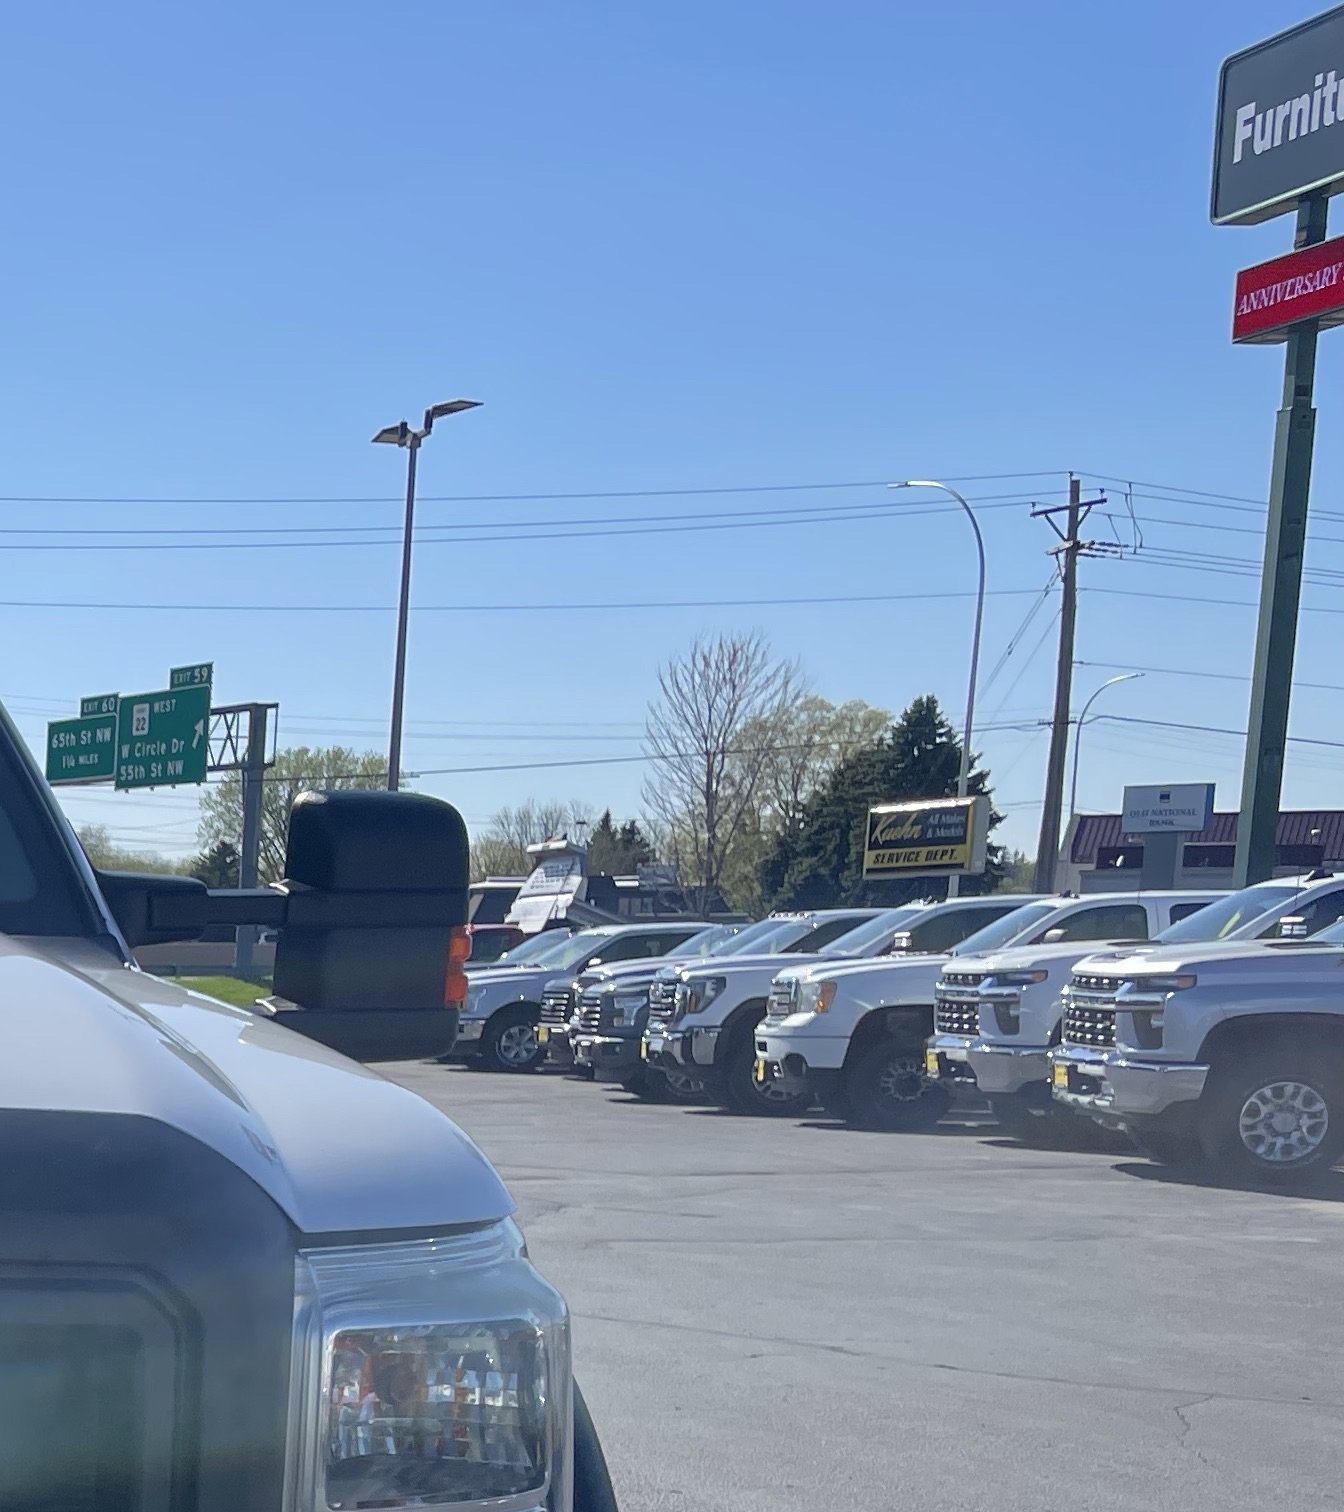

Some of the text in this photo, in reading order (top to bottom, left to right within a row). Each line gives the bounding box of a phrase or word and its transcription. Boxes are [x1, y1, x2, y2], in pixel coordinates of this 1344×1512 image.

[1237, 262, 1343, 316] ANNIVERSARY
[173, 666, 208, 684] EXIT 59
[102, 697, 115, 712] 60
[153, 699, 176, 713] WEST
[135, 716, 146, 731] 22
[52, 727, 111, 749] 65th St NW
[121, 738, 185, 759] W Circle Dr
[78, 753, 98, 765] MILES
[120, 759, 184, 781] 55th St NW
[1152, 808, 1198, 816] NATIONAL
[871, 812, 923, 846] Kuehn
[873, 851, 922, 864] SERVICE
